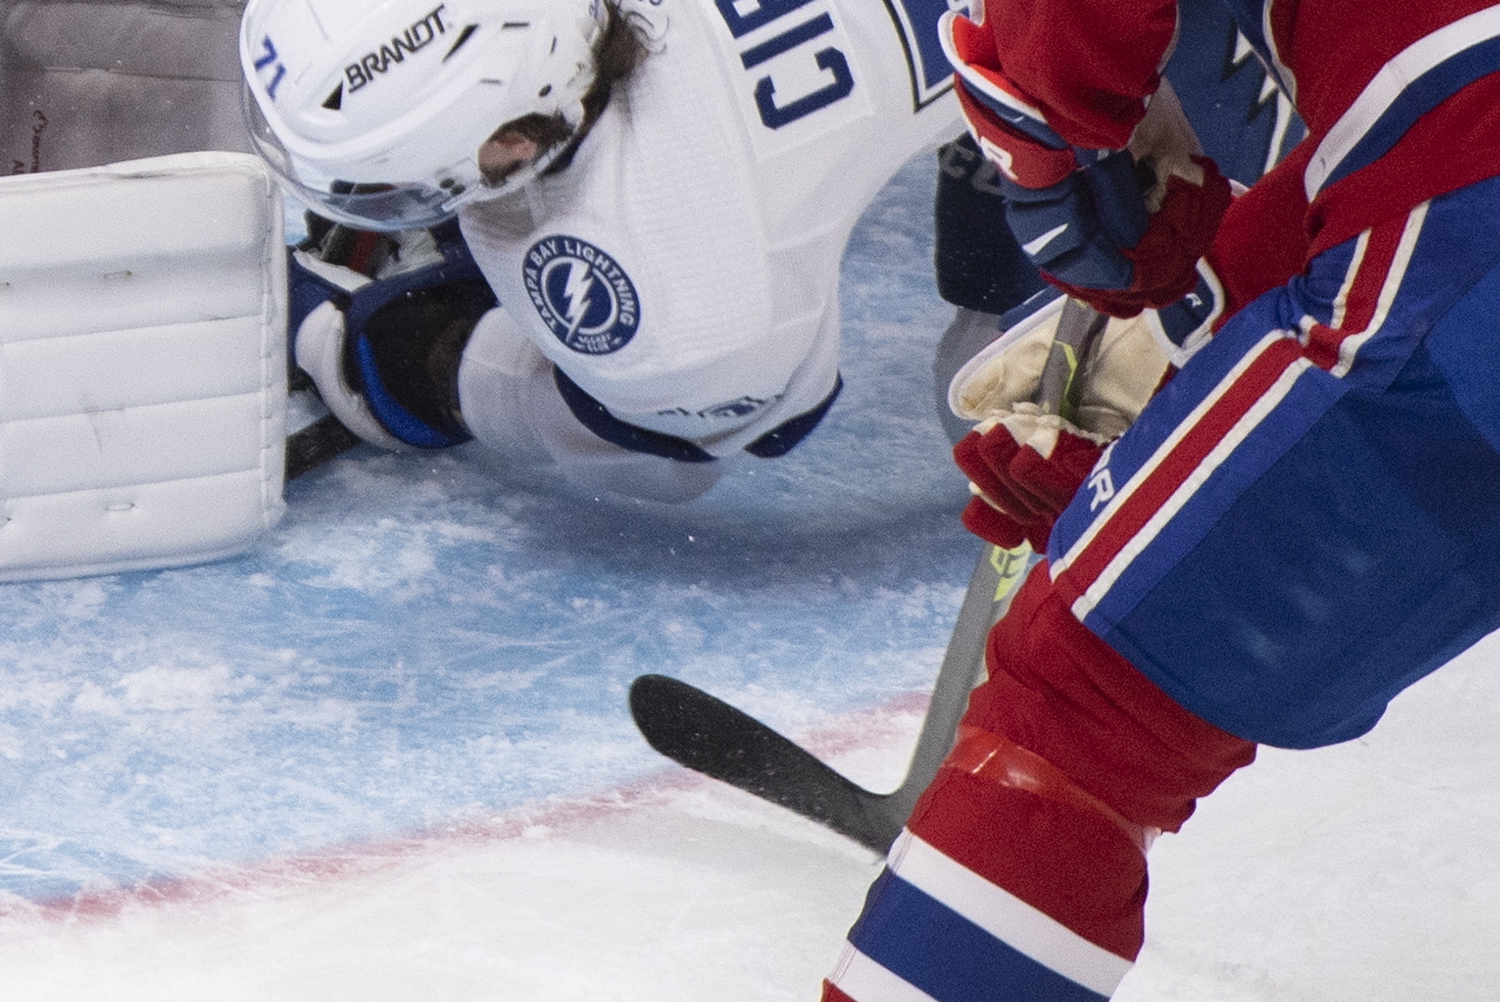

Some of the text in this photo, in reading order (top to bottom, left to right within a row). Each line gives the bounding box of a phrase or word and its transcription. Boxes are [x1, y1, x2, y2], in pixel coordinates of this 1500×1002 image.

[254, 33, 288, 102] 71
[344, 2, 448, 94] BRANDT
[529, 239, 559, 267] BAY
[563, 239, 635, 327] LIGHTNING
